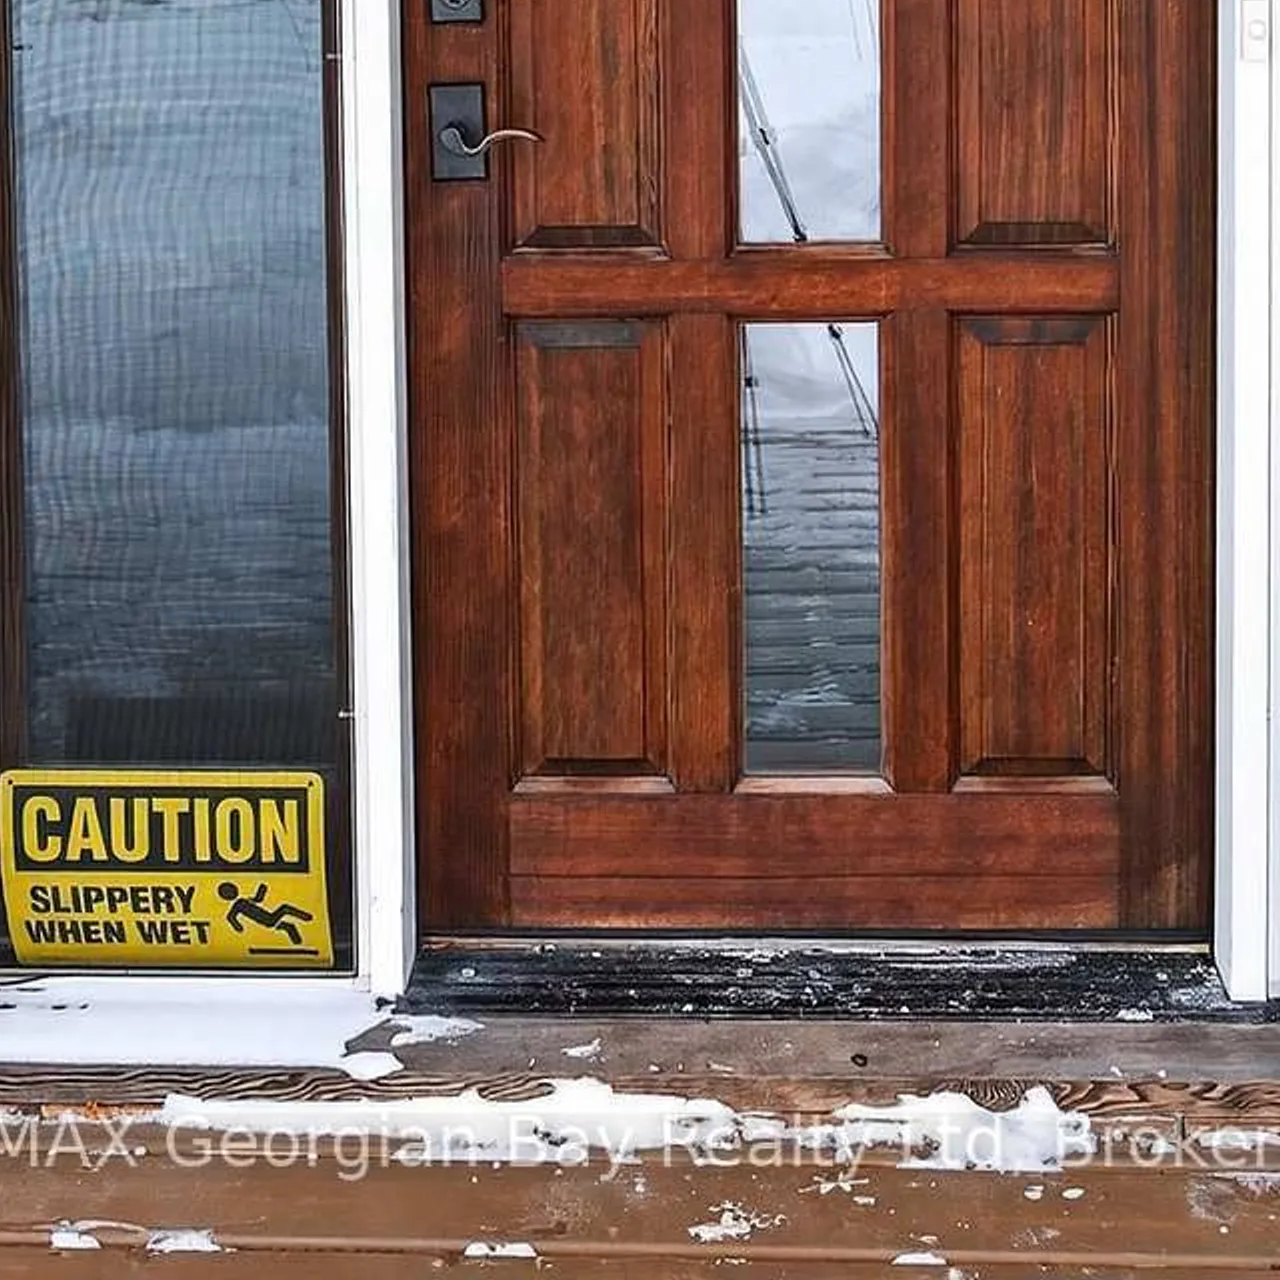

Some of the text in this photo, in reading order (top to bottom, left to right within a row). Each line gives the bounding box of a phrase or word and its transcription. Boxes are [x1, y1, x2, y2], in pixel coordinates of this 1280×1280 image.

[23, 796, 299, 864] CAUTION
[30, 885, 196, 914] SLIPPERY
[26, 920, 210, 945] WHEN WET
